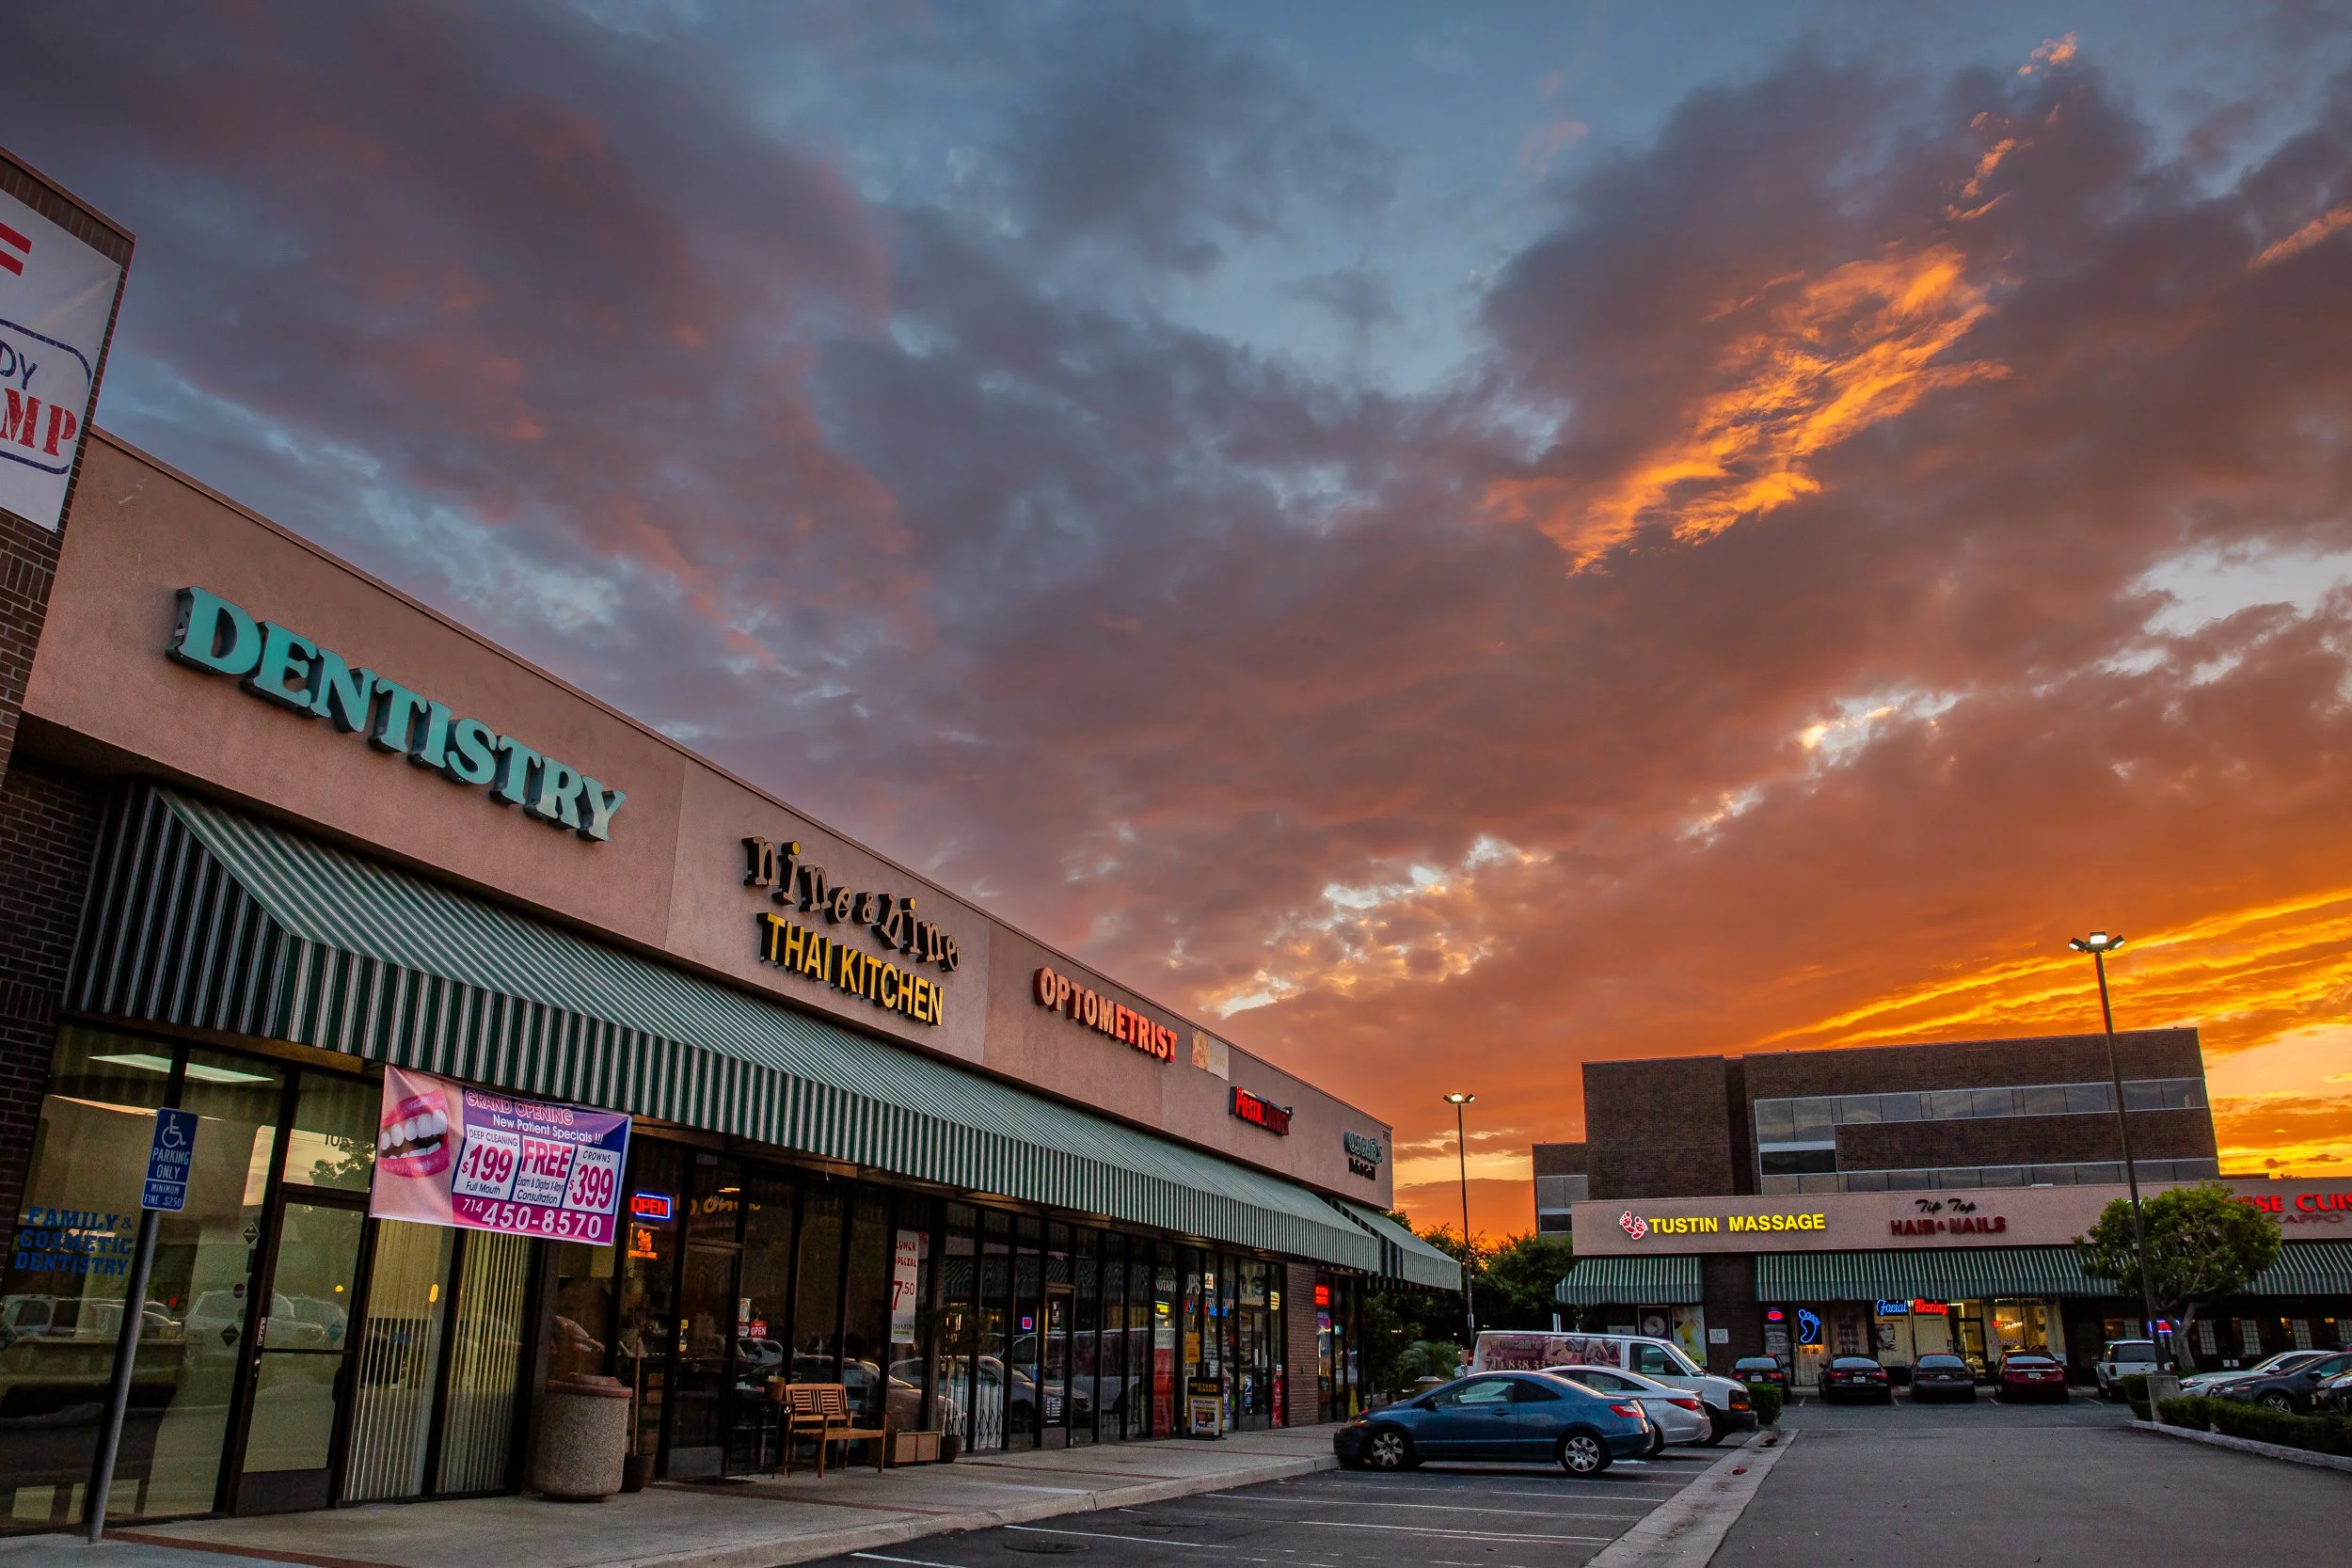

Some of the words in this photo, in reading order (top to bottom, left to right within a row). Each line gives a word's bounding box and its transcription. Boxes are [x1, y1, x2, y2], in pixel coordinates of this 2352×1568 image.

[167, 585, 627, 842] DENTISTRY
[758, 911, 832, 982] THAI
[834, 943, 945, 1026] KITCHEN
[1035, 967, 1178, 1063] OPTOMETRIST
[466, 1089, 512, 1114] GRAND
[515, 1101, 574, 1126] OPENING
[469, 1129, 483, 1141] DEEP
[486, 1131, 518, 1147] CLEANING
[493, 1114, 515, 1129] New
[516, 1118, 550, 1136] Patient
[552, 1126, 593, 1145] Specials
[152, 1148, 190, 1164] PARKING
[521, 1139, 573, 1179] FREE
[582, 1150, 612, 1164] CROWNS
[156, 1164, 182, 1180] ONLY
[151, 1183, 180, 1195] MINIMUM
[466, 1181, 478, 1193] Full
[480, 1183, 501, 1196] Mouth
[516, 1190, 558, 1205] Consultation
[144, 1195, 159, 1205] FINE
[163, 1196, 183, 1208] $250
[630, 1196, 667, 1215] OPEN
[26, 1206, 119, 1231] FAMILY
[120, 1216, 133, 1230] &
[462, 1198, 484, 1213] 714
[482, 1203, 602, 1239] 450-8570
[1649, 1216, 1719, 1235] TUSTIN
[1728, 1213, 1826, 1233] MASSAGE
[1890, 1219, 1936, 1236] HAIR
[1948, 1216, 2007, 1234] NAILS
[19, 1228, 134, 1255] COSMETIC
[14, 1251, 129, 1276] DENTISTRY
[1876, 1299, 1908, 1316] Facial
[750, 1326, 767, 1336] OPEN
